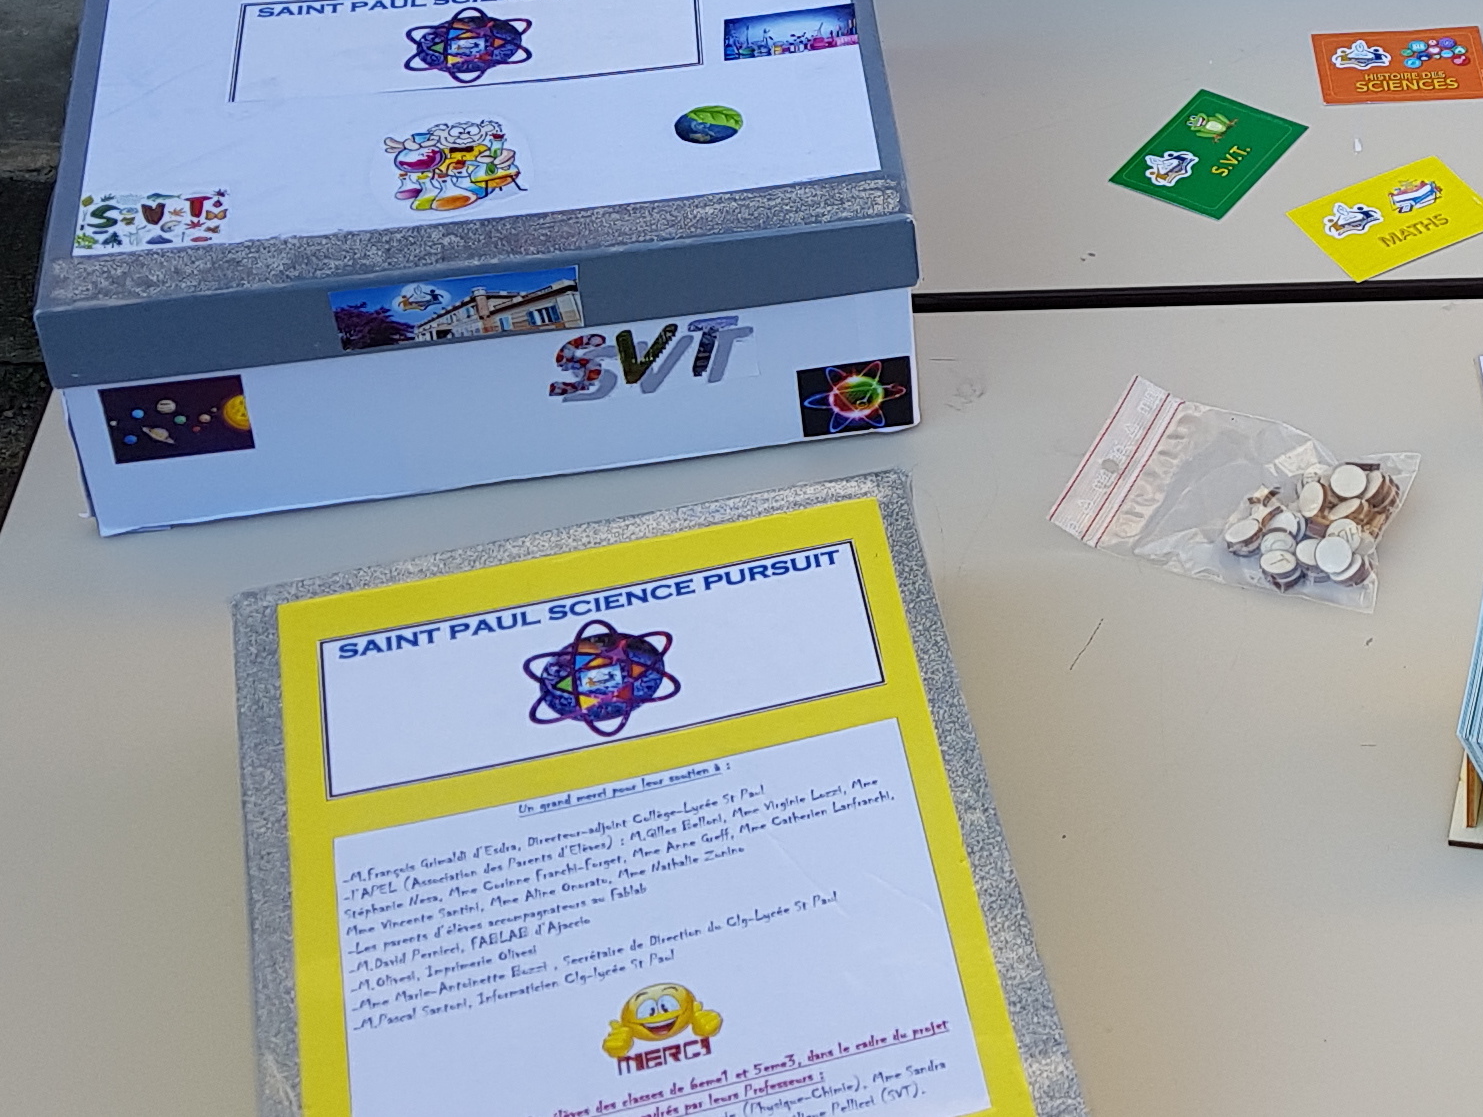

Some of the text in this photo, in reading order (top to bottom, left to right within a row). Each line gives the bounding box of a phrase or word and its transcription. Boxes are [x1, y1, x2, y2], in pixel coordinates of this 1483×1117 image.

[257, 2, 343, 18] SAINT
[1355, 77, 1459, 93] SCIENCES
[1210, 144, 1252, 178] S.V.T.
[1378, 212, 1450, 248] MATHS
[549, 316, 744, 398] SVT
[339, 550, 836, 659] SAINT PAUL SCIENCE PURSUIT
